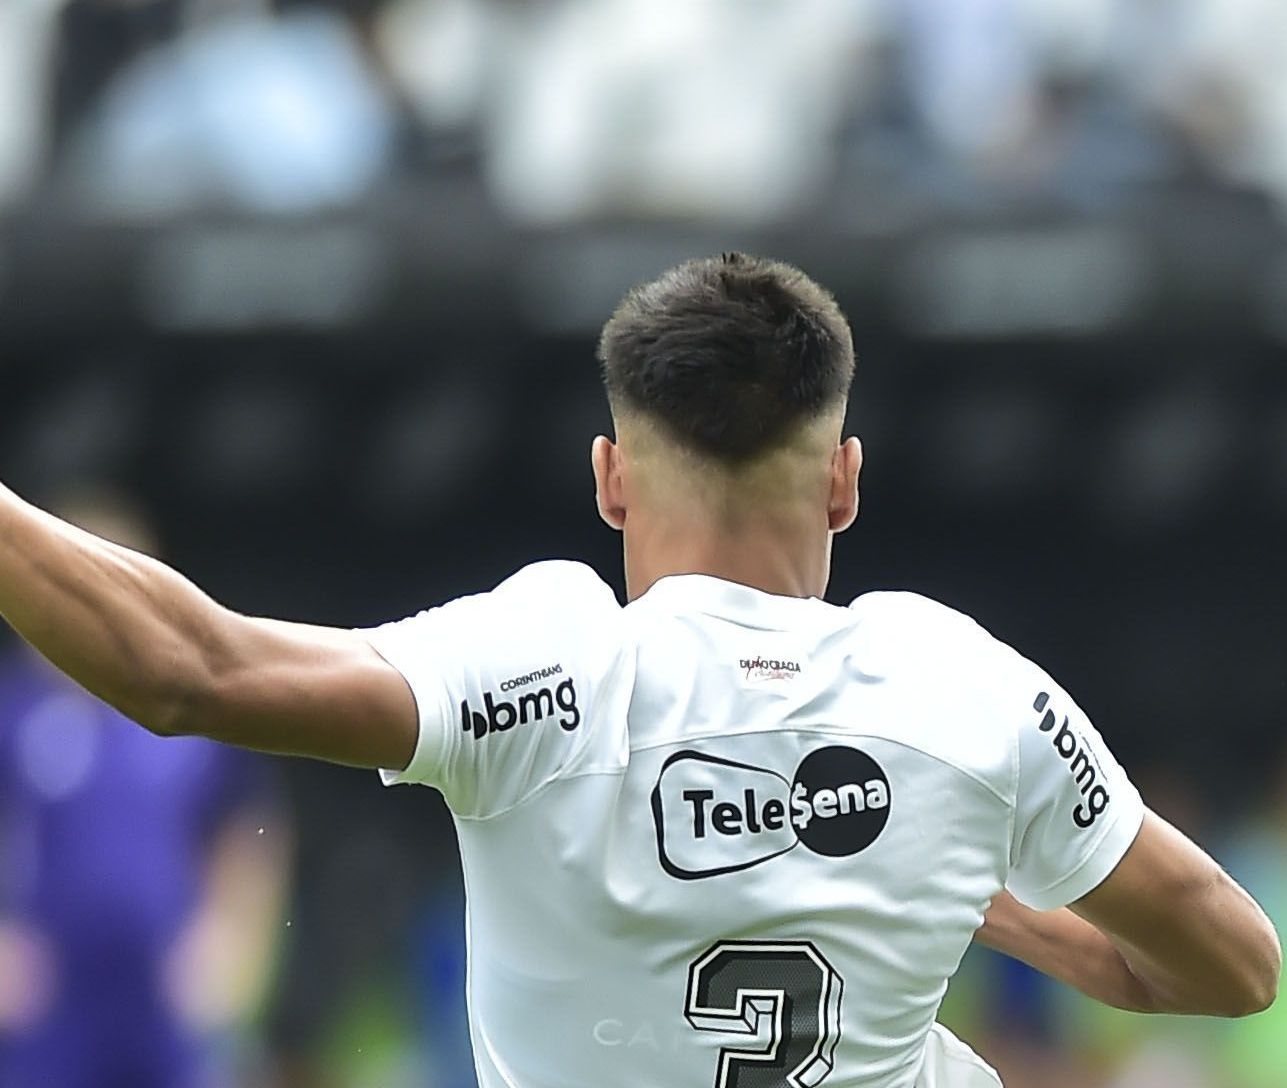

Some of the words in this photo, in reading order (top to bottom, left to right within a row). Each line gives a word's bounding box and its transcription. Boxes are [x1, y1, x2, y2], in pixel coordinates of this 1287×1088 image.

[483, 676, 580, 733] bmg
[500, 663, 563, 692] CORINTHIANS
[1053, 714, 1110, 828] bmg
